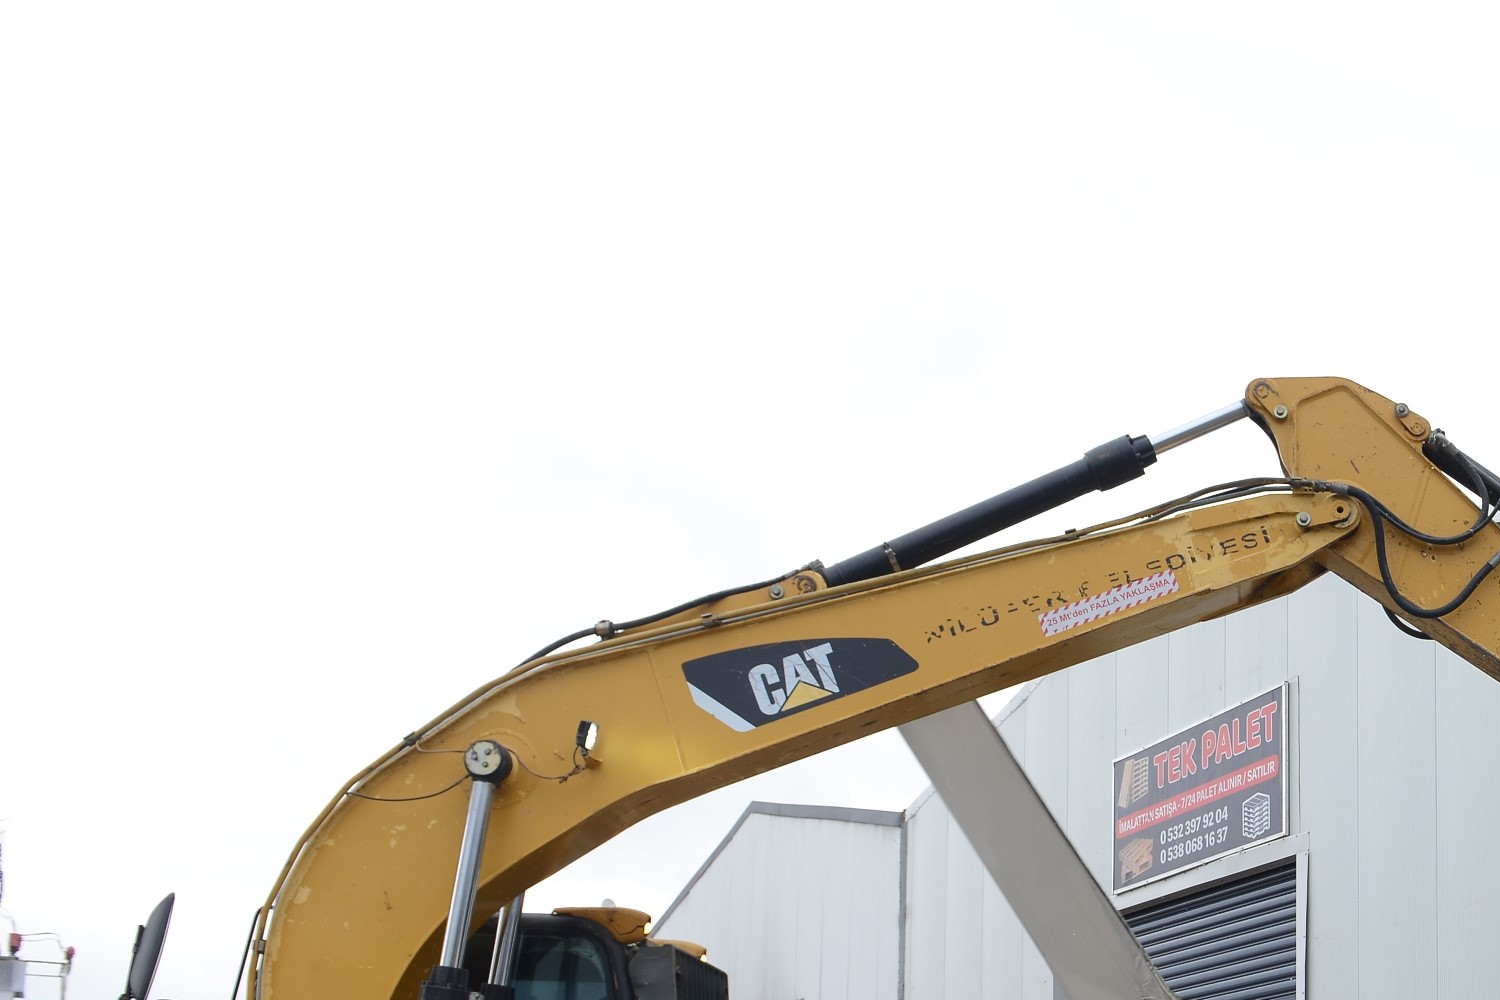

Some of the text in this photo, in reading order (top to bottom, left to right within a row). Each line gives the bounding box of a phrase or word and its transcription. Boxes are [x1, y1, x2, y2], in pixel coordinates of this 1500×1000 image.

[1047, 578, 1170, 627] 25 Mt'den FAZLA YAKLAŞMA
[748, 642, 840, 716] CAT
[1153, 701, 1278, 789] TEK PALET
[1119, 811, 1155, 834] İMALATTAN
[1155, 805, 1177, 819] SATIŞA
[1181, 795, 1196, 809] 7/24
[1196, 785, 1218, 803] PALET
[1218, 775, 1243, 795] ALINIR
[1247, 760, 1275, 783] SATILIR
[1160, 806, 1228, 845] 0 532 397 92 04
[1160, 826, 1228, 864] 0 538 068 16 37
